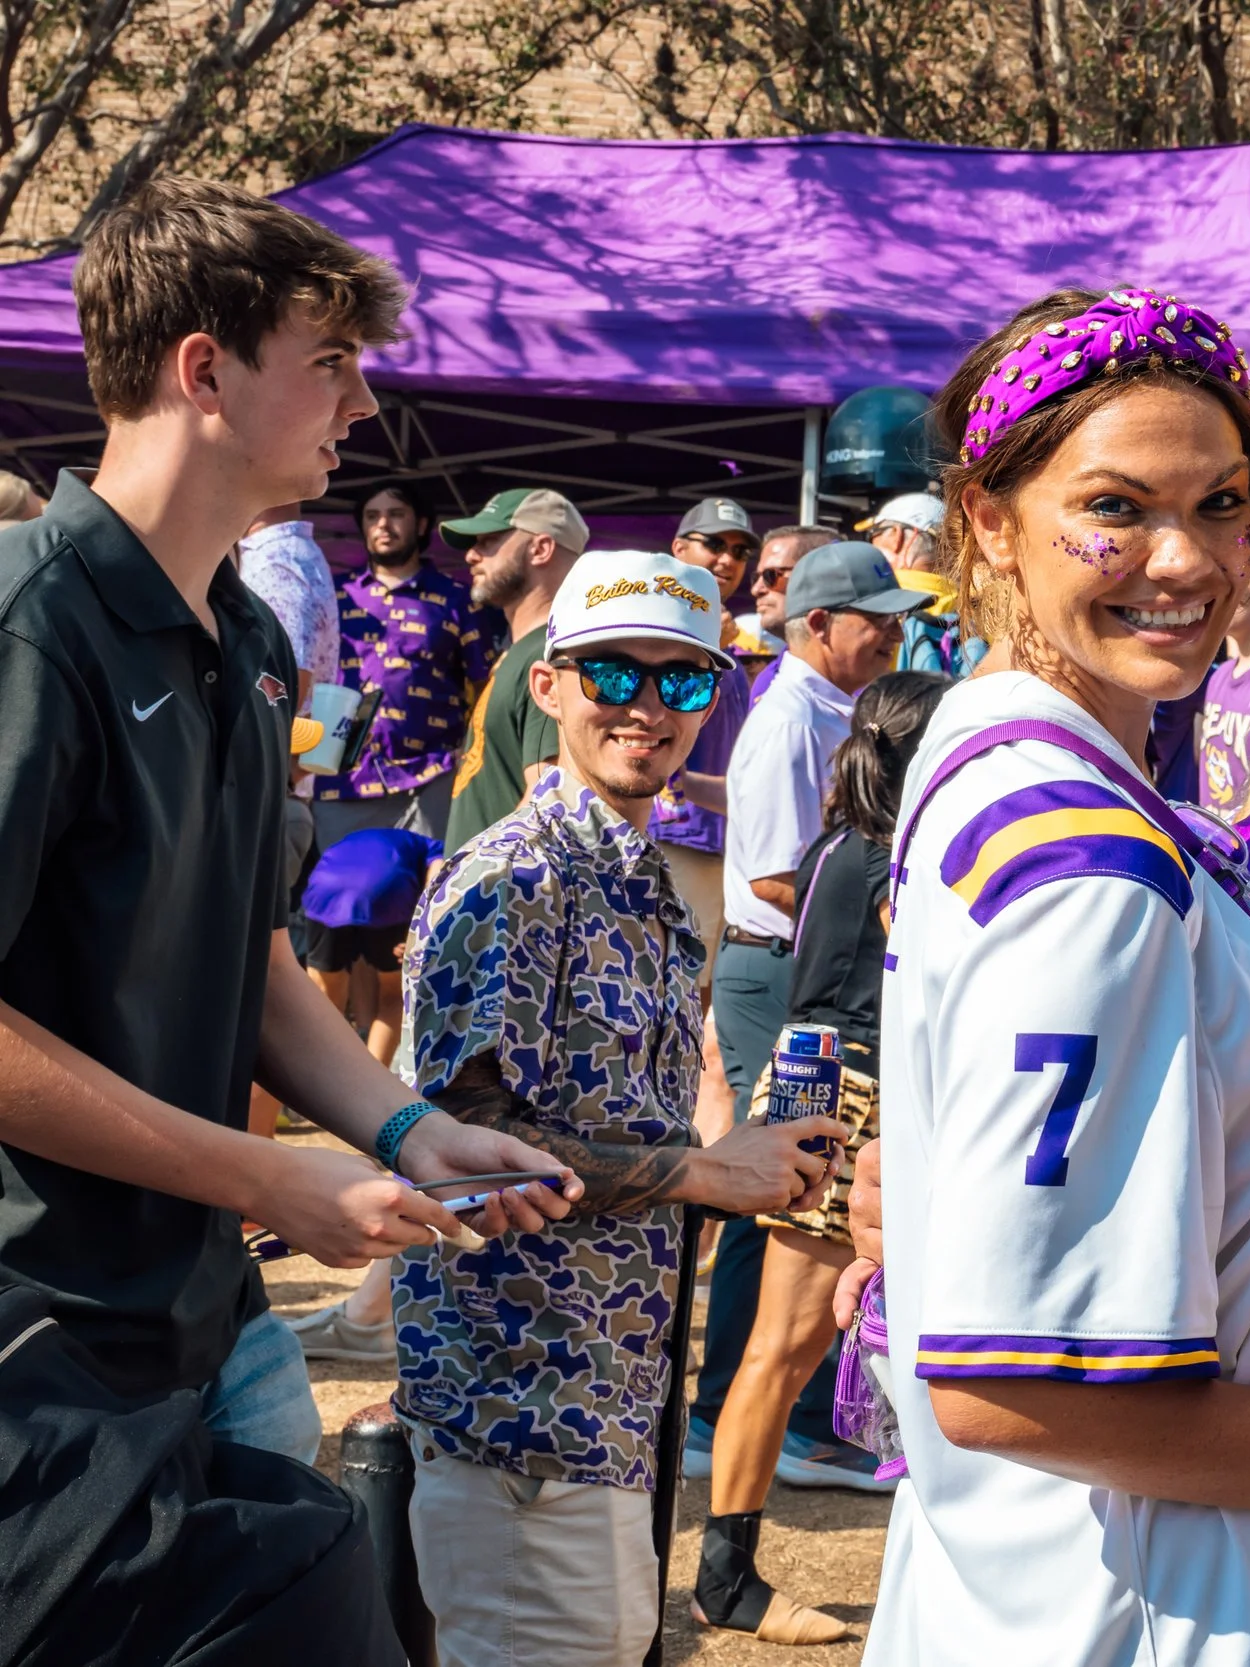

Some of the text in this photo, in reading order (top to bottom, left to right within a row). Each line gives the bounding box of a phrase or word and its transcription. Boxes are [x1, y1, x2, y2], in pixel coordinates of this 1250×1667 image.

[585, 574, 711, 612] Baton Rouge
[788, 1066, 819, 1075] LIGHT
[808, 1081, 832, 1101] LES
[780, 1099, 828, 1117] LIGHTS
[1014, 1032, 1098, 1187] 7
